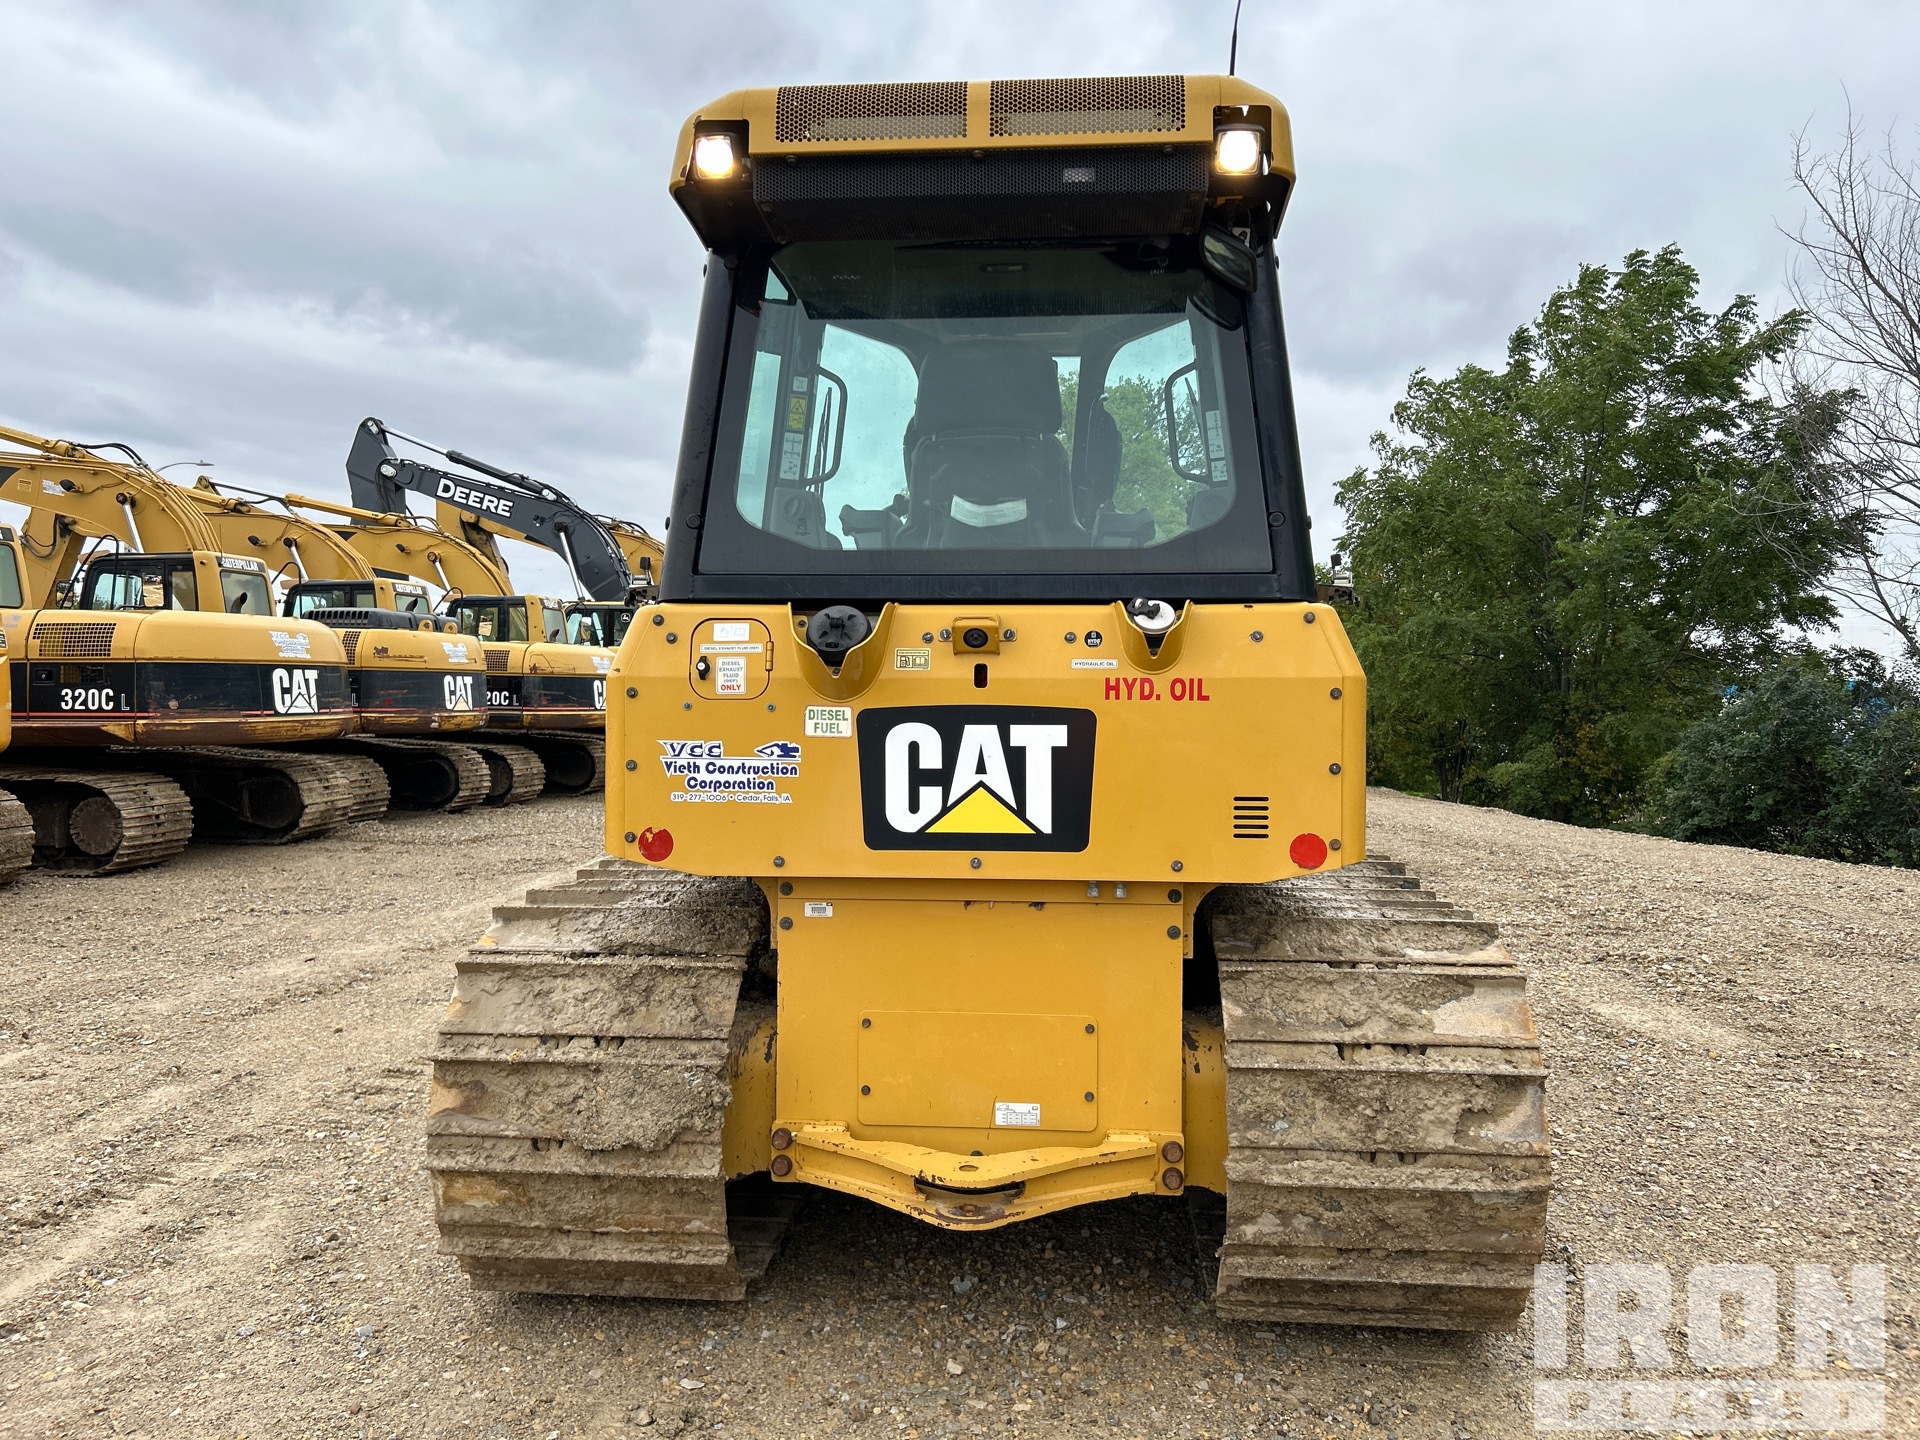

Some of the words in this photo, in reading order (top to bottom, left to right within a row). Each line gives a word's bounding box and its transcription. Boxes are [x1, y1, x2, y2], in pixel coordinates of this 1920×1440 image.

[436, 477, 514, 518] DEERE
[221, 557, 260, 571] CATERPILLAR
[272, 667, 319, 714] CAT
[443, 674, 473, 711] CAT
[1104, 677, 1161, 701] HYD.
[1169, 677, 1210, 702] OIL
[60, 688, 114, 711] 320C
[121, 694, 130, 711] L
[486, 690, 509, 706] 20C
[512, 694, 520, 706] L
[808, 709, 849, 721] DIESEL
[814, 722, 843, 734] FUEL
[663, 742, 722, 758] VCC
[664, 760, 700, 774] Vieth
[705, 761, 798, 776] Construction
[686, 776, 774, 792] Corporation
[884, 722, 1068, 834] CAT
[672, 793, 727, 802] 319-277-1006
